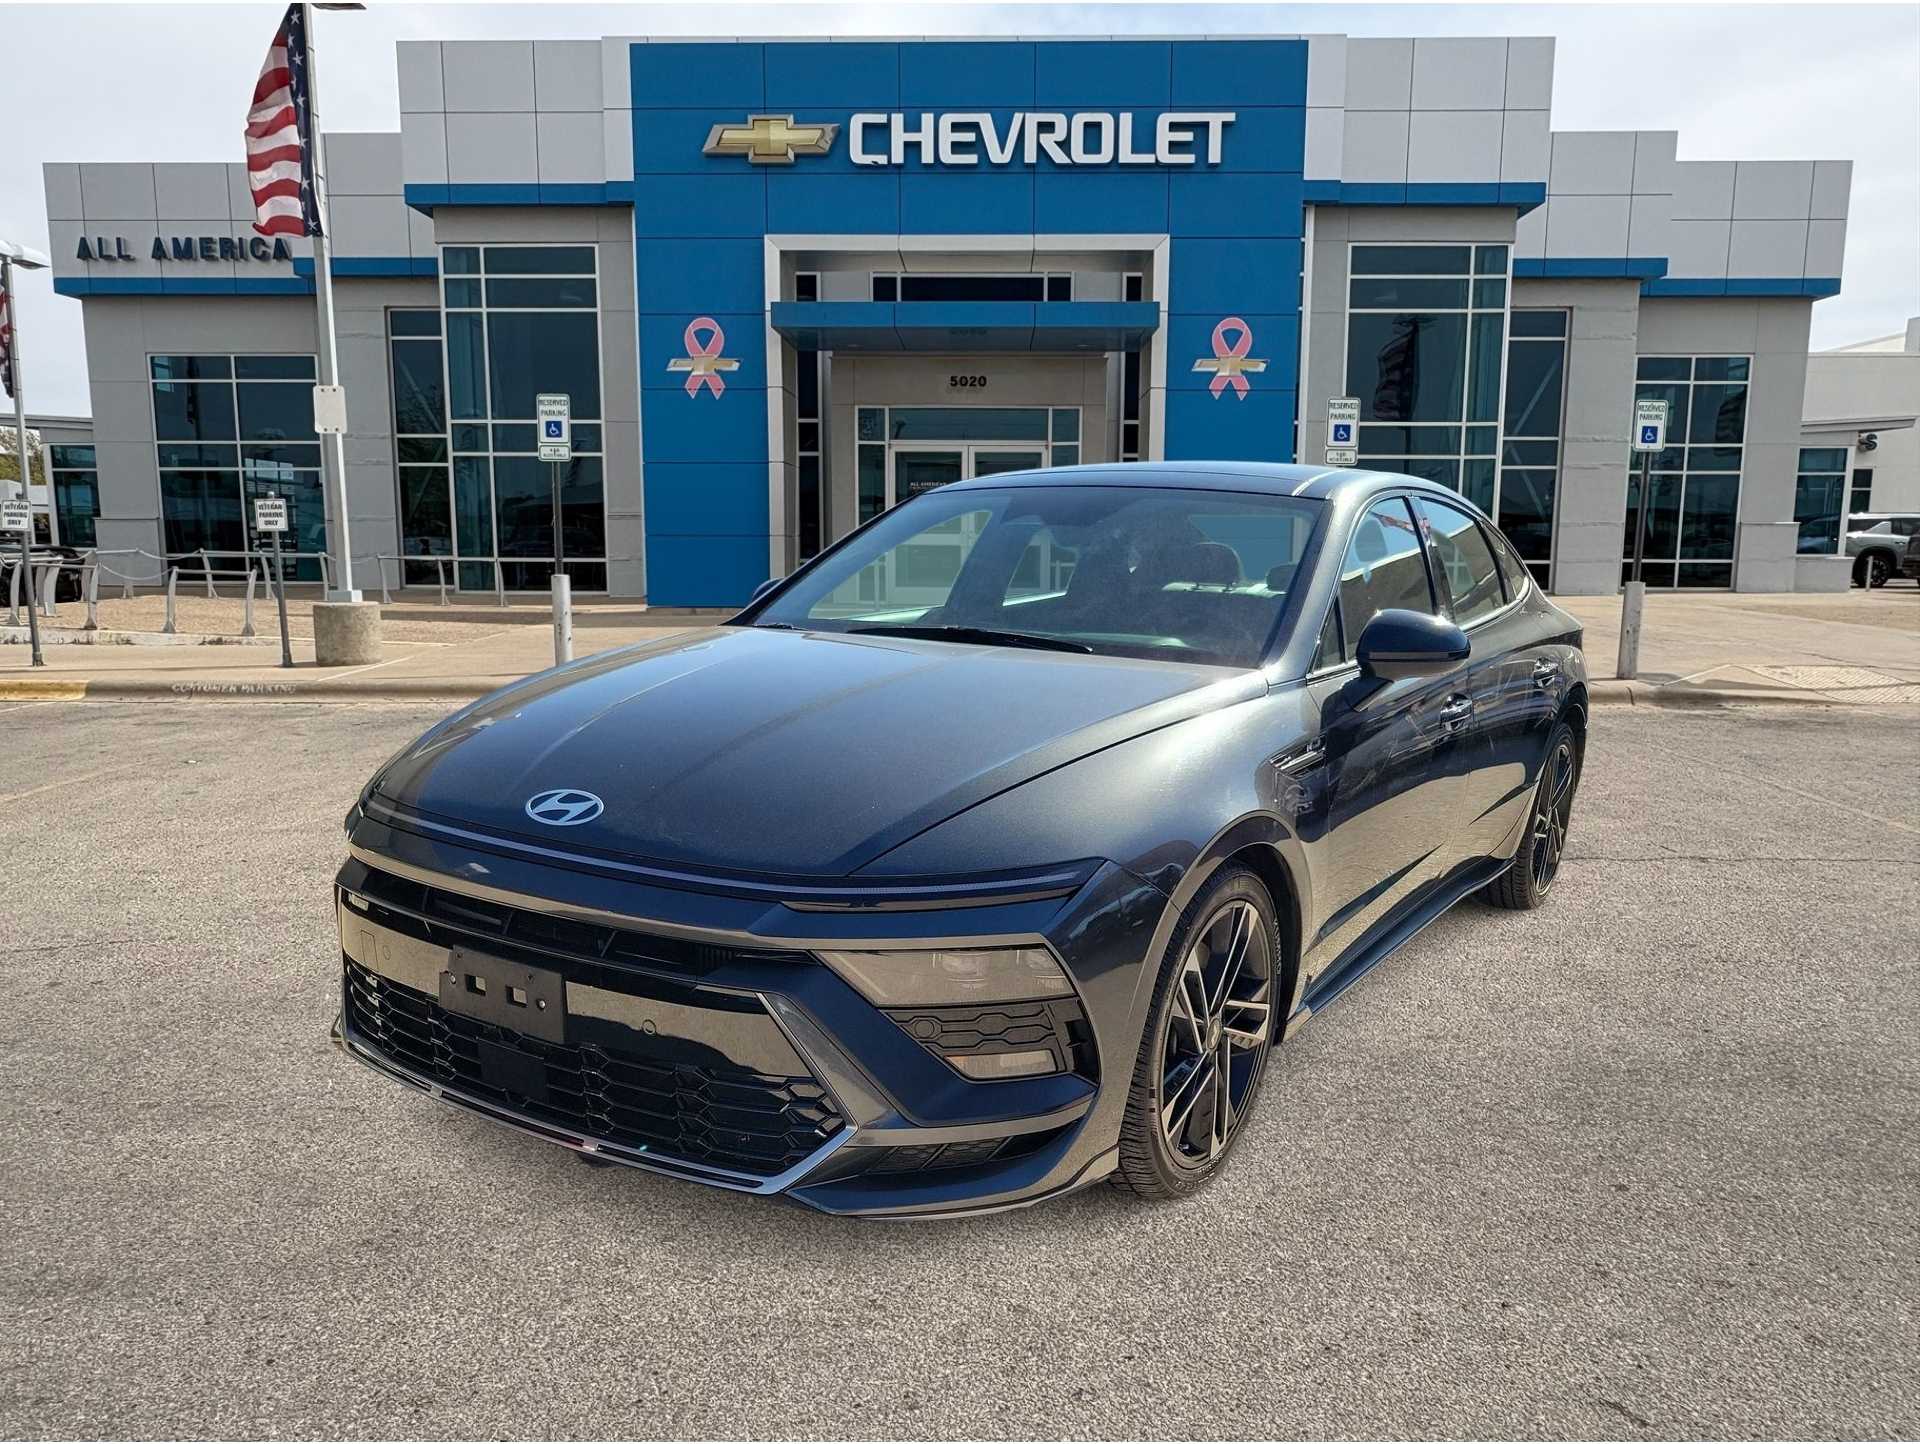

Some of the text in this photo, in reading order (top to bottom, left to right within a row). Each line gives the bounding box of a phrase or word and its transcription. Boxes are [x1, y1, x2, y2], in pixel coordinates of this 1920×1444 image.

[849, 112, 1236, 165] CHEVROLET
[76, 236, 134, 261] ALL
[950, 375, 987, 387] 5020
[541, 409, 567, 417] PARKING
